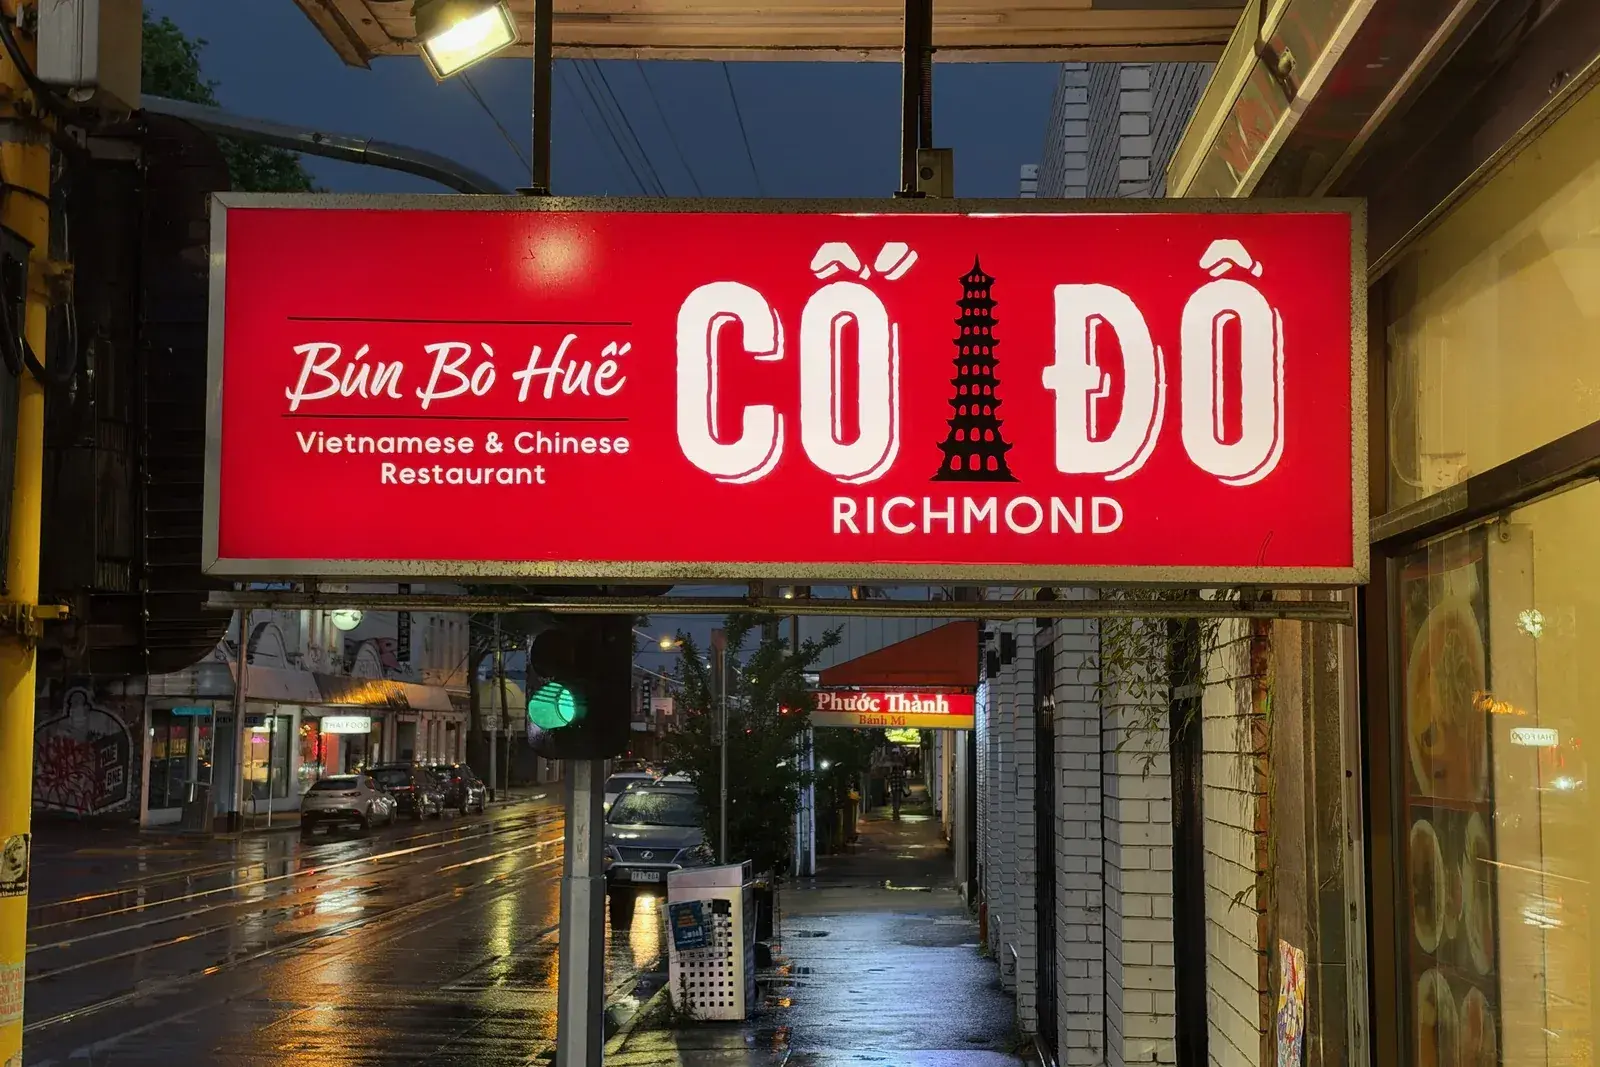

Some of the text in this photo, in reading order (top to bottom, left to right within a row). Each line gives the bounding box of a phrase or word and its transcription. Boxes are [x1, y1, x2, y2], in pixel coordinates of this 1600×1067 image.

[286, 334, 632, 412] Bún Bò Huế
[677, 240, 1285, 487] CỐ ĐÔ
[297, 432, 630, 454] Vietnamese & Chinese
[381, 463, 546, 485] Restaurant
[834, 497, 1124, 535] RICHMOND
[817, 692, 950, 714] Phước Thành
[859, 714, 887, 725] Bánh
